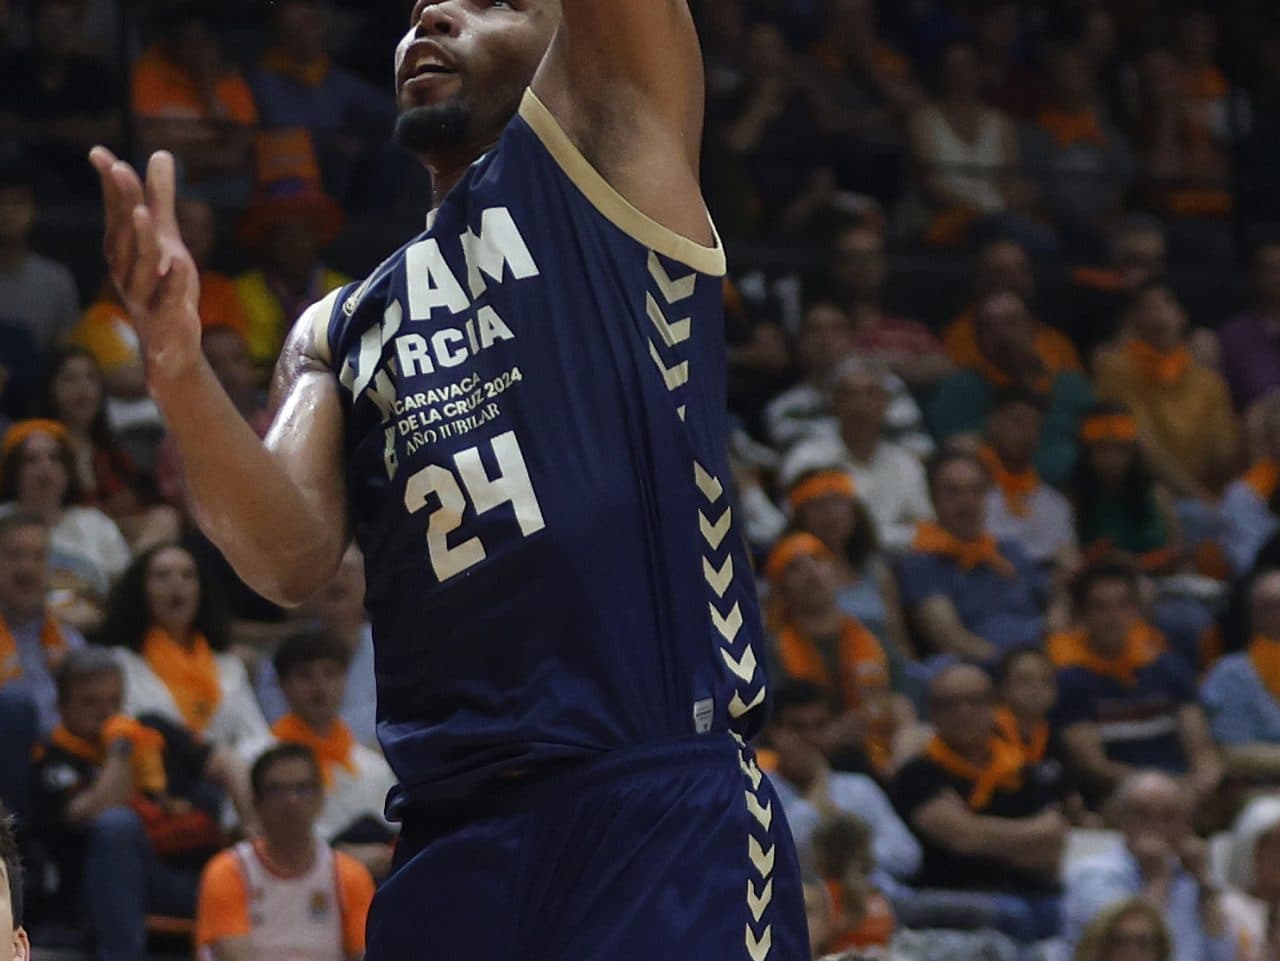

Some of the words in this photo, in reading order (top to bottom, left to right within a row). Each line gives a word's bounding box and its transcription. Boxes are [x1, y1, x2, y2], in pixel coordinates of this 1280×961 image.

[395, 371, 481, 415] CARAVACA
[398, 413, 418, 436] DE
[420, 408, 442, 427] LA
[443, 390, 485, 418] CRUZ
[485, 366, 523, 398] 2024
[406, 429, 437, 456] AÑO
[404, 430, 546, 583] 24
